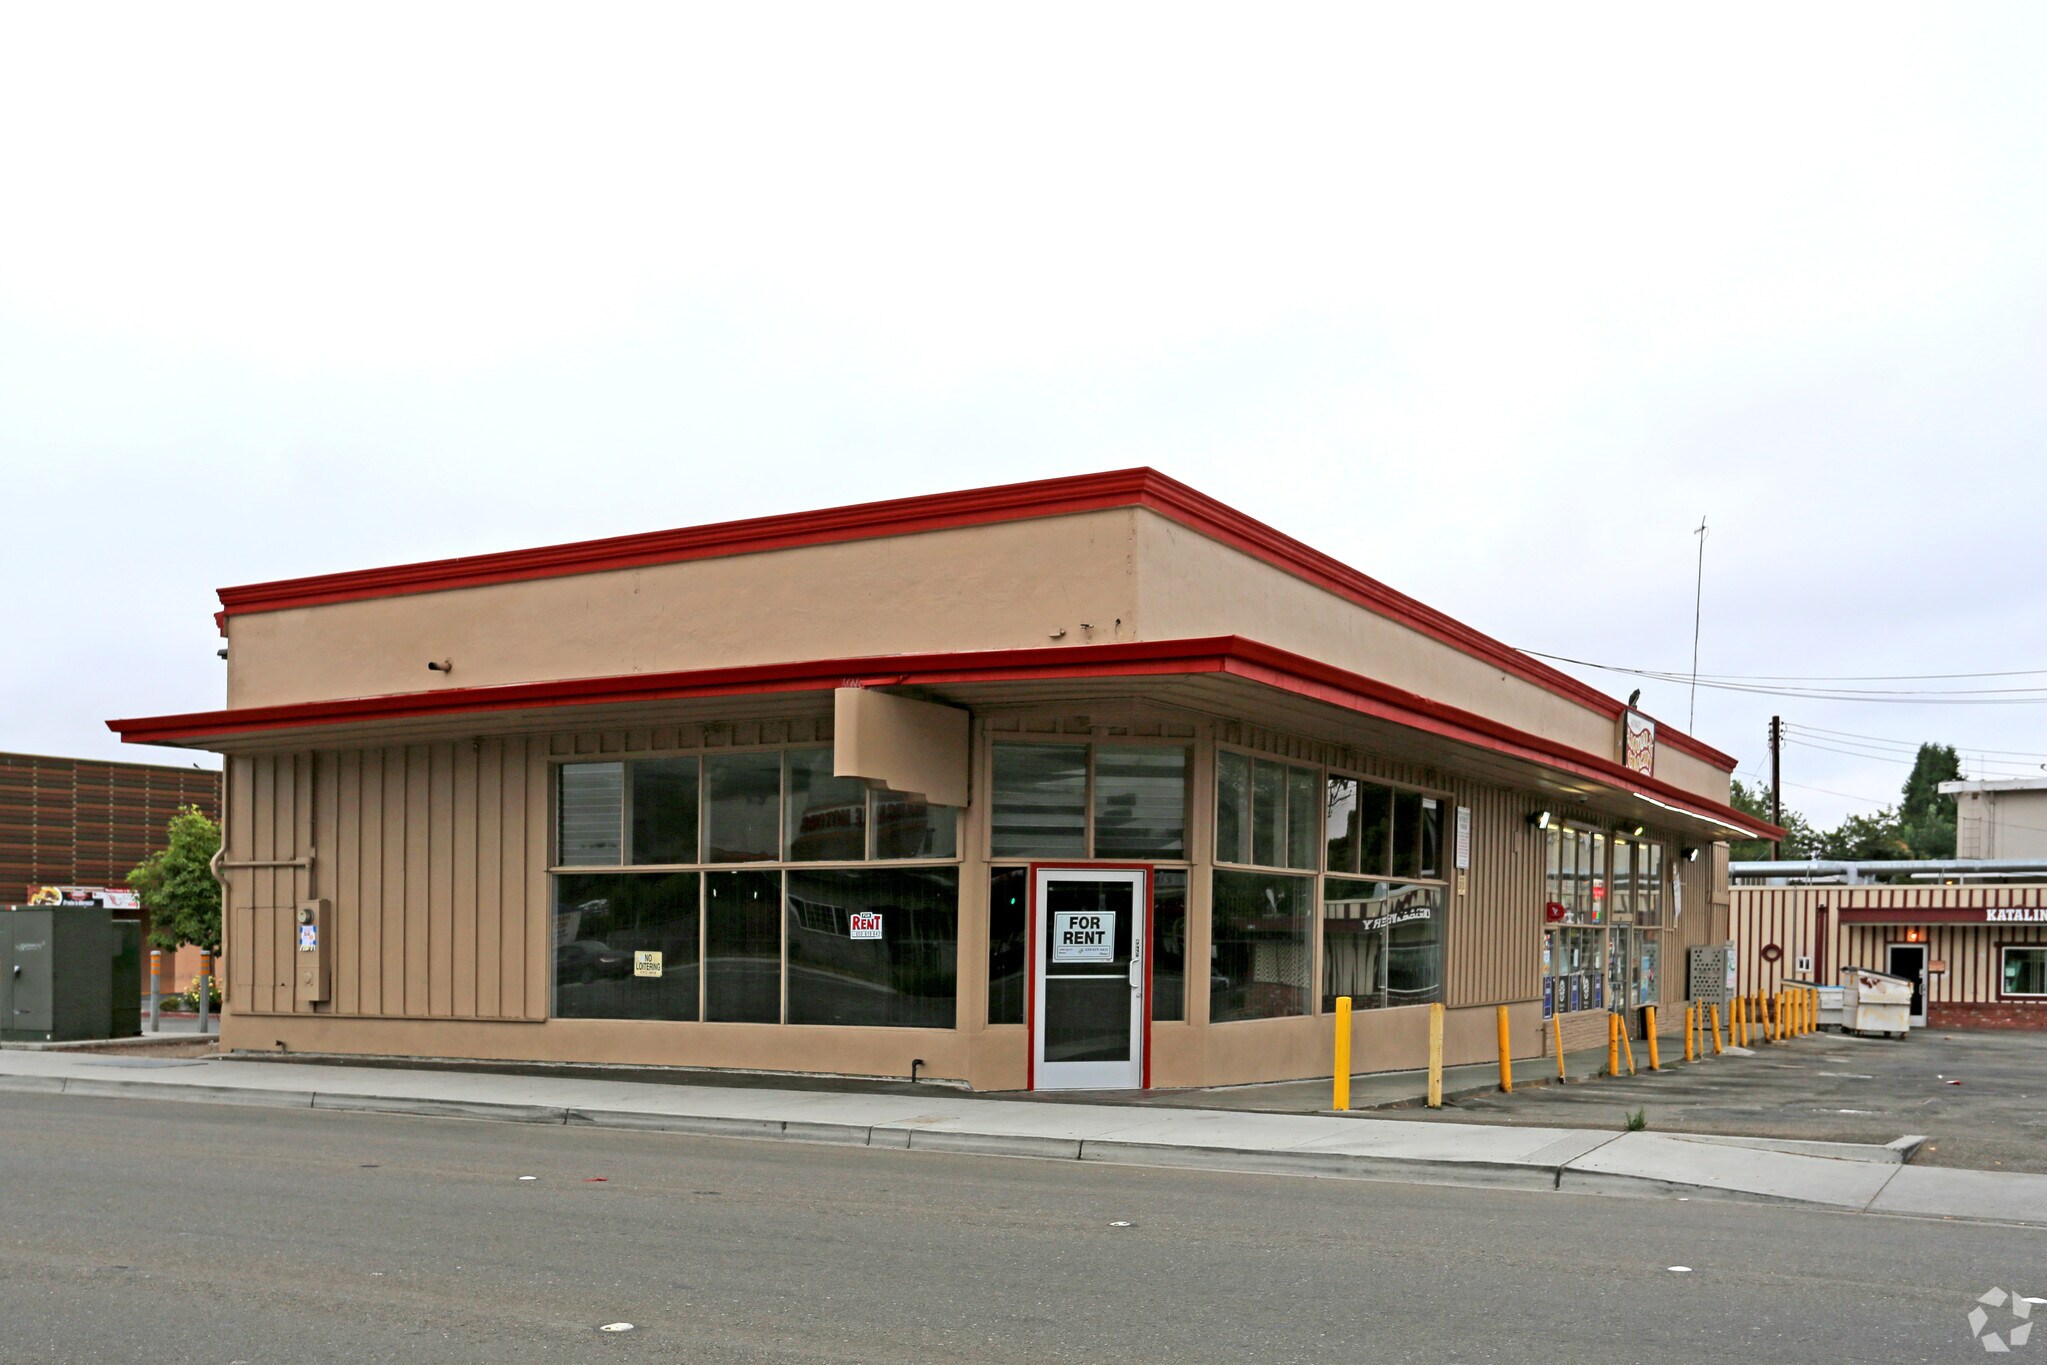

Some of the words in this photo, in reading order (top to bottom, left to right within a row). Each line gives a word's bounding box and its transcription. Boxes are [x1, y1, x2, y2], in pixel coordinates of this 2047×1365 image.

[1986, 909, 2047, 922] KATALIN
[852, 915, 881, 930] RENT
[1069, 916, 1100, 929] FOR
[1063, 931, 1105, 945] RENT
[644, 954, 653, 962] NO
[636, 962, 661, 971] LOITERING
